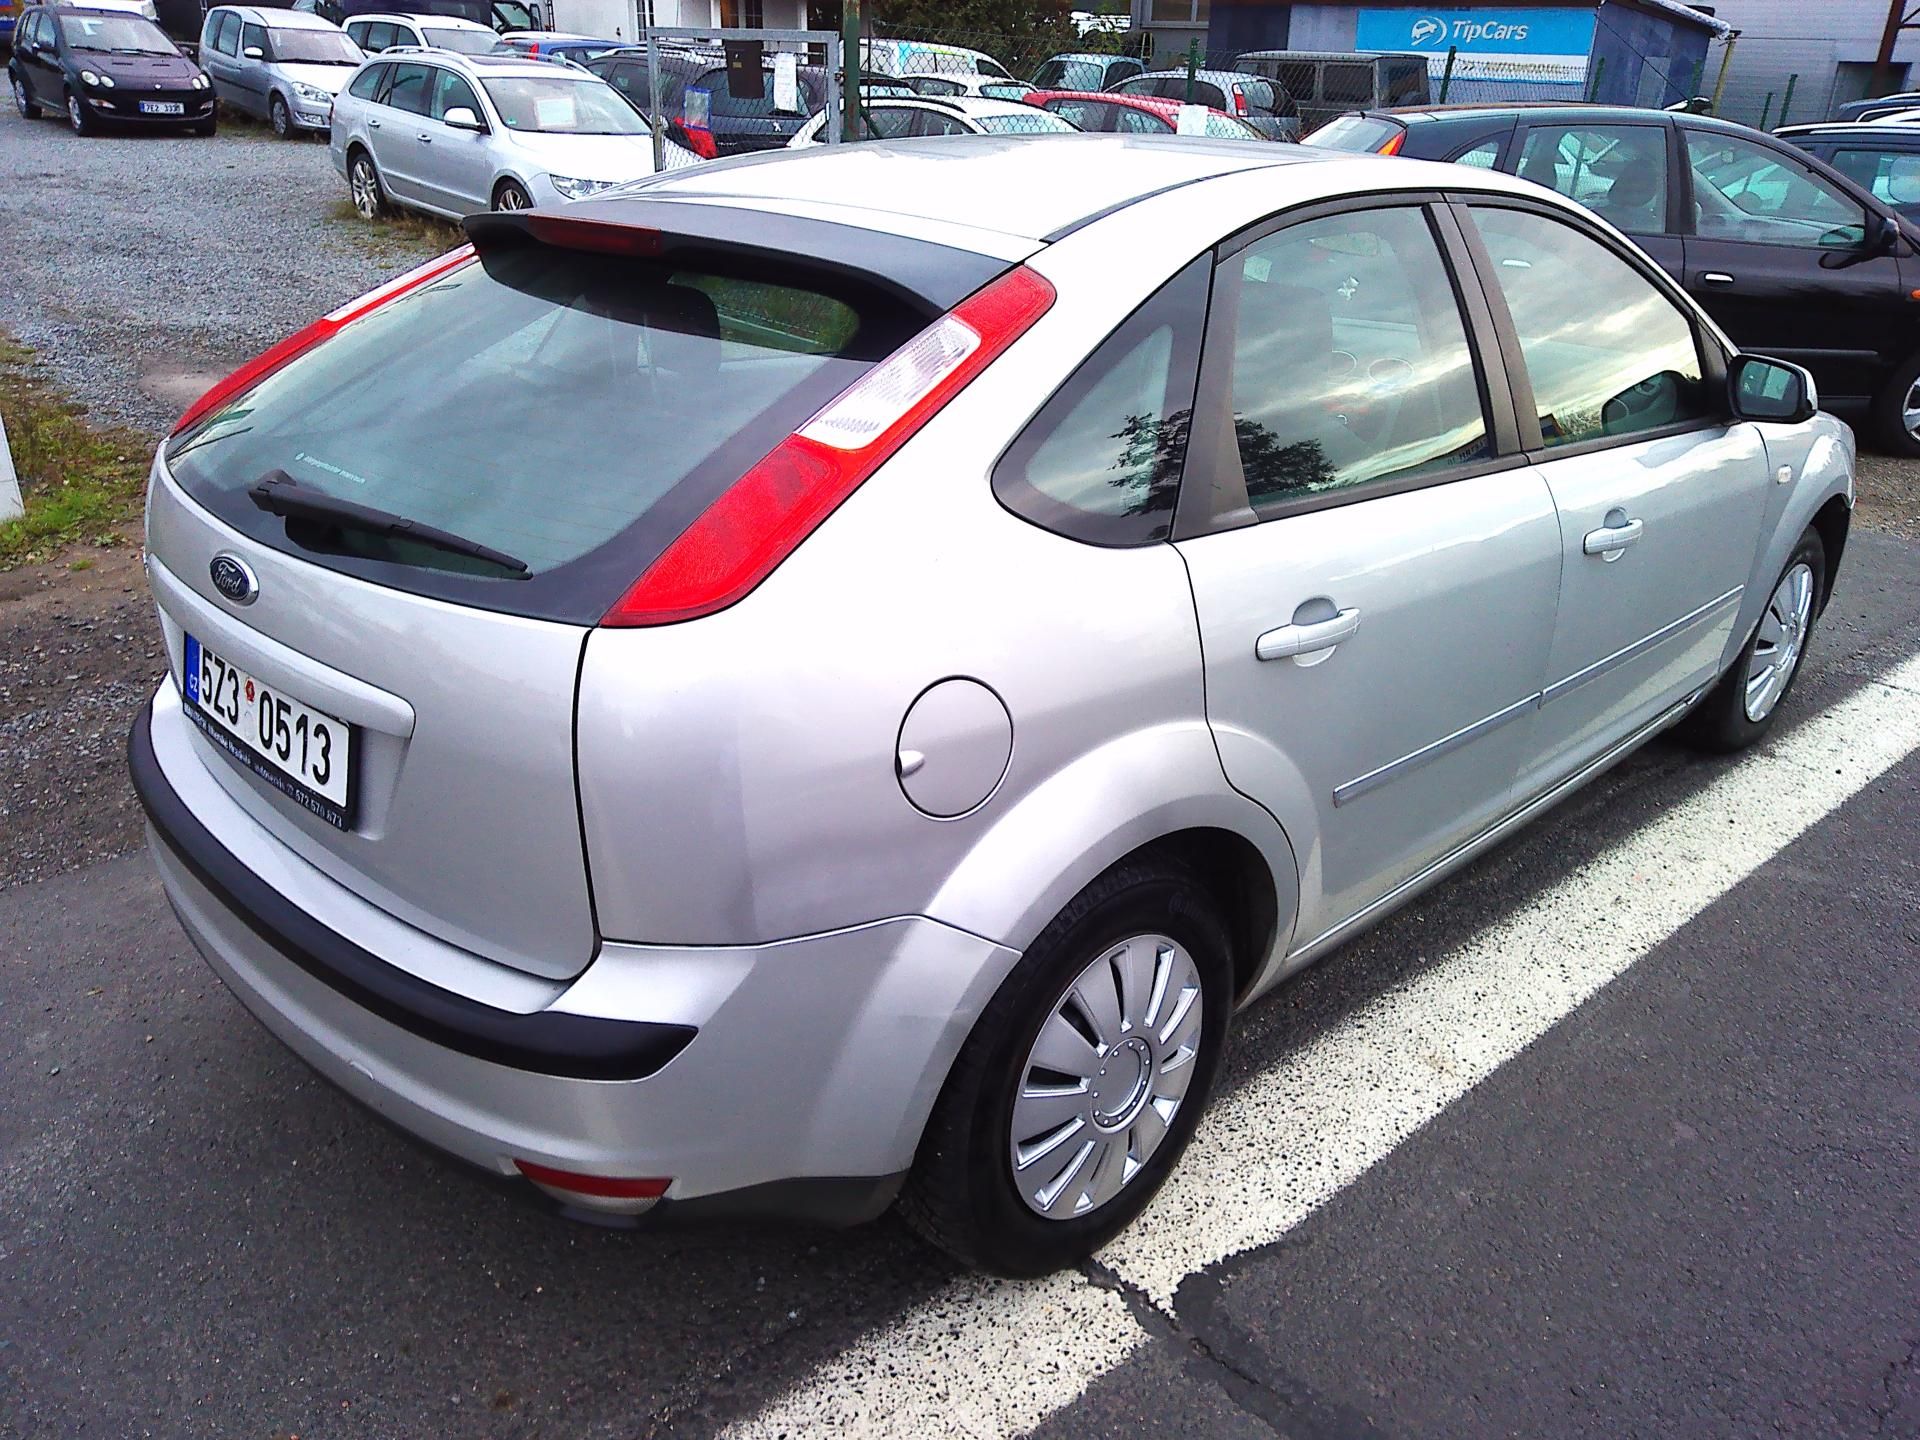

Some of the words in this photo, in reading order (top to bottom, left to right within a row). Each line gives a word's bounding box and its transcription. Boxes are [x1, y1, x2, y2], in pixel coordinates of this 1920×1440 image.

[1452, 20, 1529, 44] TipCars
[215, 561, 242, 593] Ford
[202, 648, 240, 725] 5Z3
[259, 690, 332, 786] 0513
